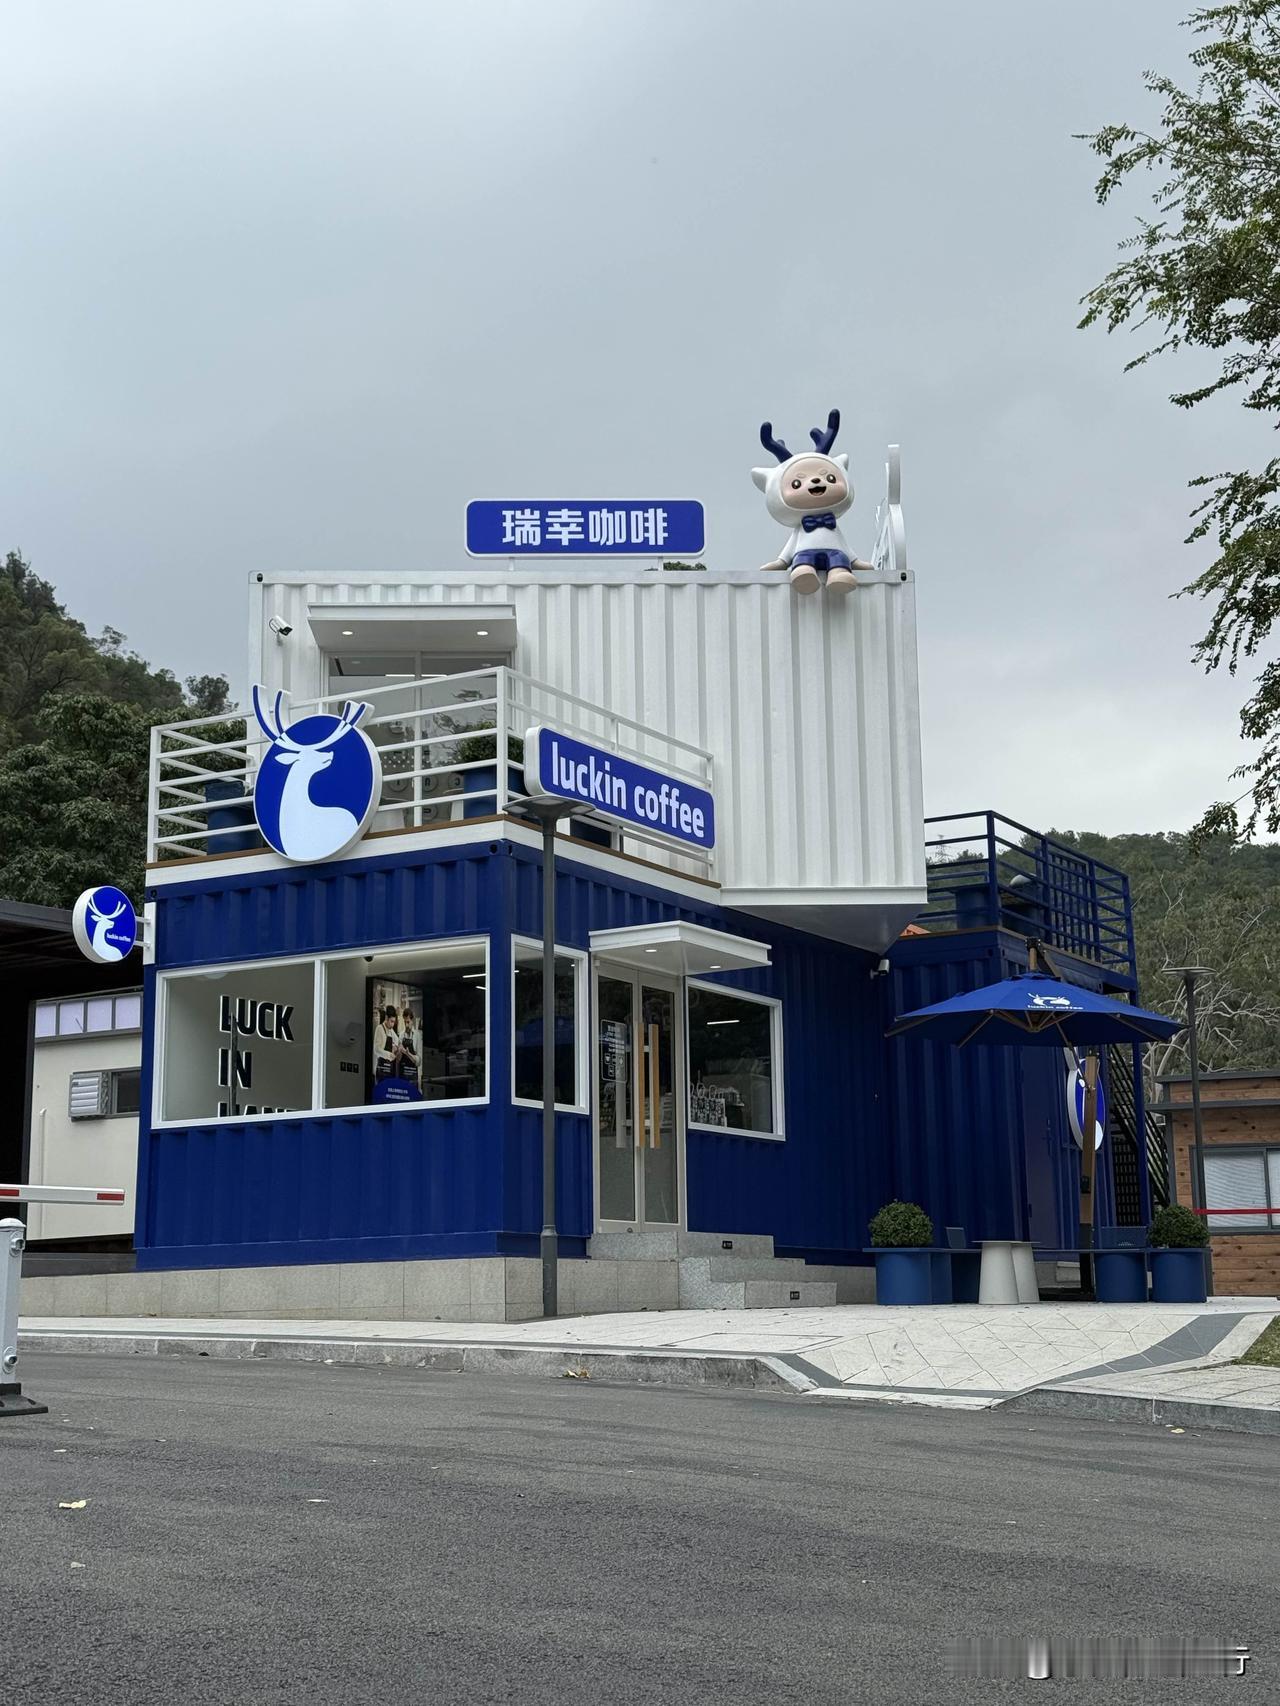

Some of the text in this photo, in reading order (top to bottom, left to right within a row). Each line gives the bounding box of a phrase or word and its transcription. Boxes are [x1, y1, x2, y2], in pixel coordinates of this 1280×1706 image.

[501, 508, 669, 546] 瑞幸咖啡
[552, 741, 705, 838] luckin coffee
[219, 994, 295, 1042] LUCK
[218, 1047, 252, 1090] IN
